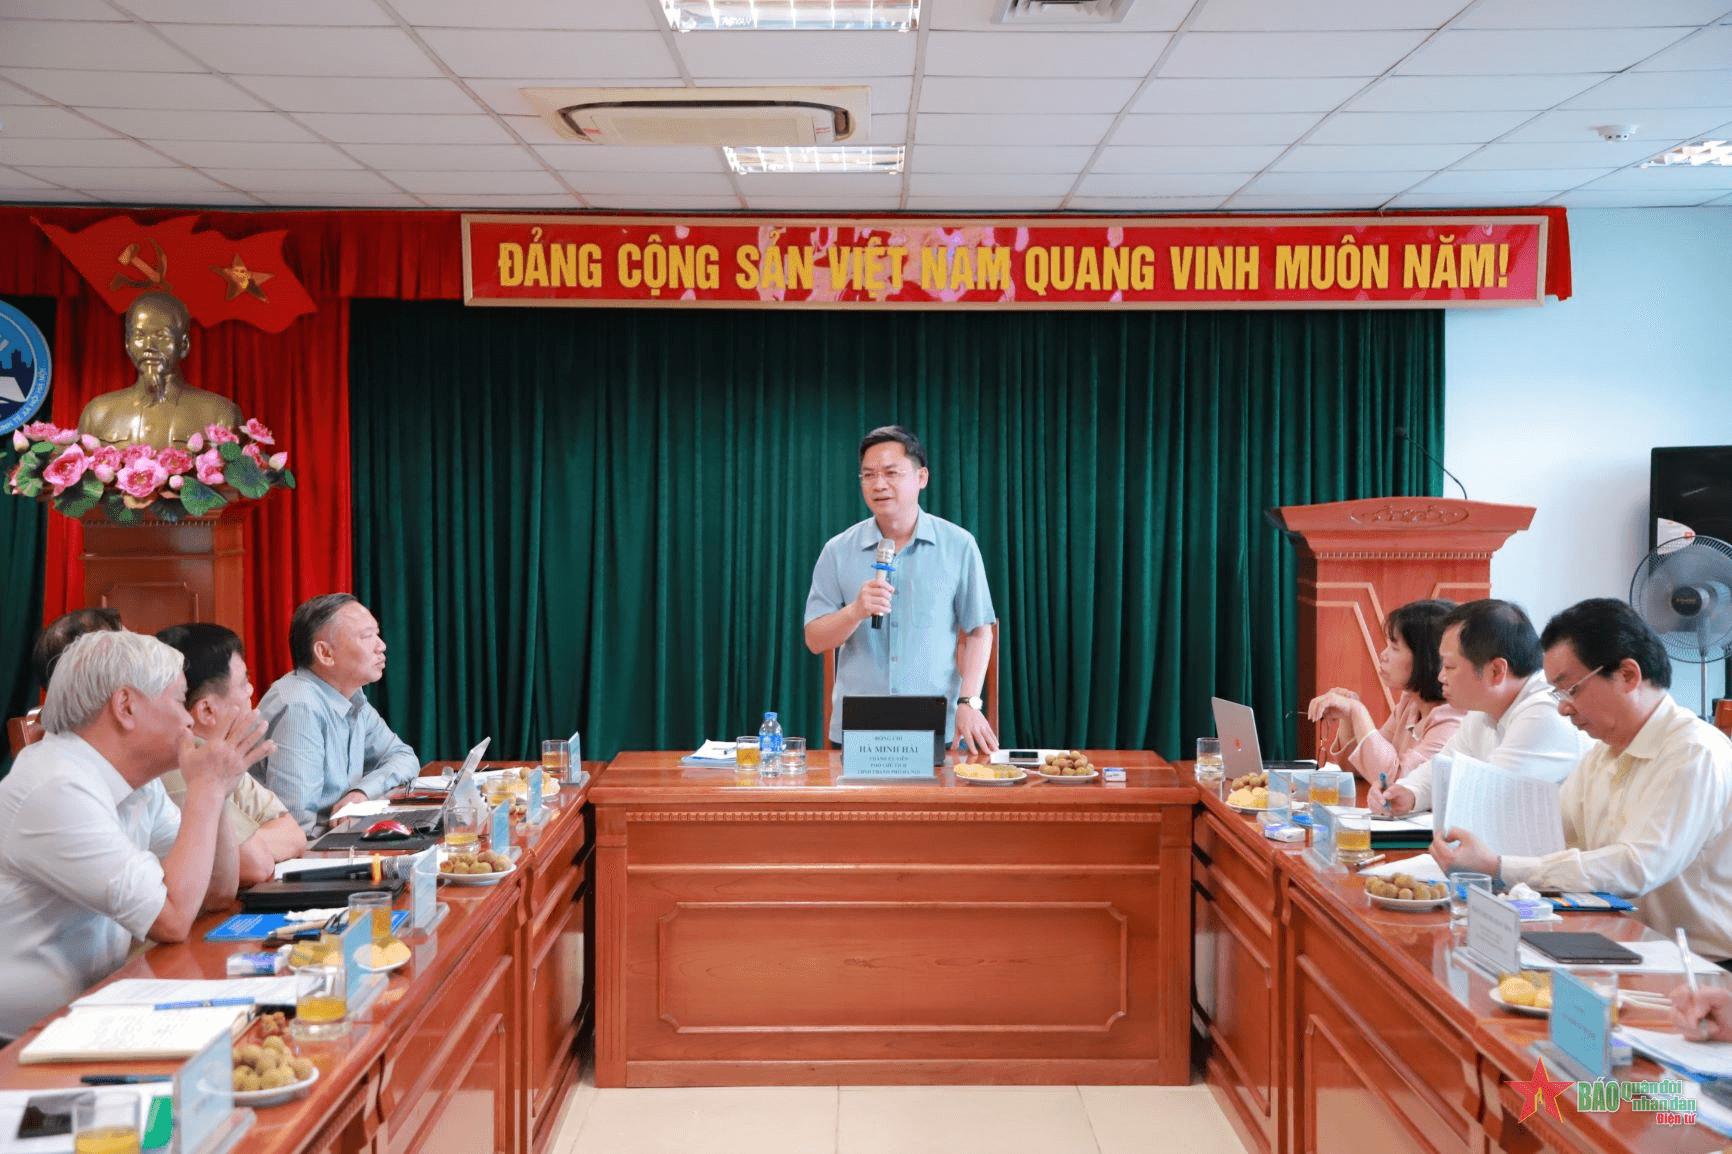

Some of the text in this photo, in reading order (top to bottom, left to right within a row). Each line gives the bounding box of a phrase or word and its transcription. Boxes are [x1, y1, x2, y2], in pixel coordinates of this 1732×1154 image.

[498, 227, 1509, 298] ĐẢNG CỘNG SẢN VIỆT NAM QUANG VINH MUÔN NĂM!
